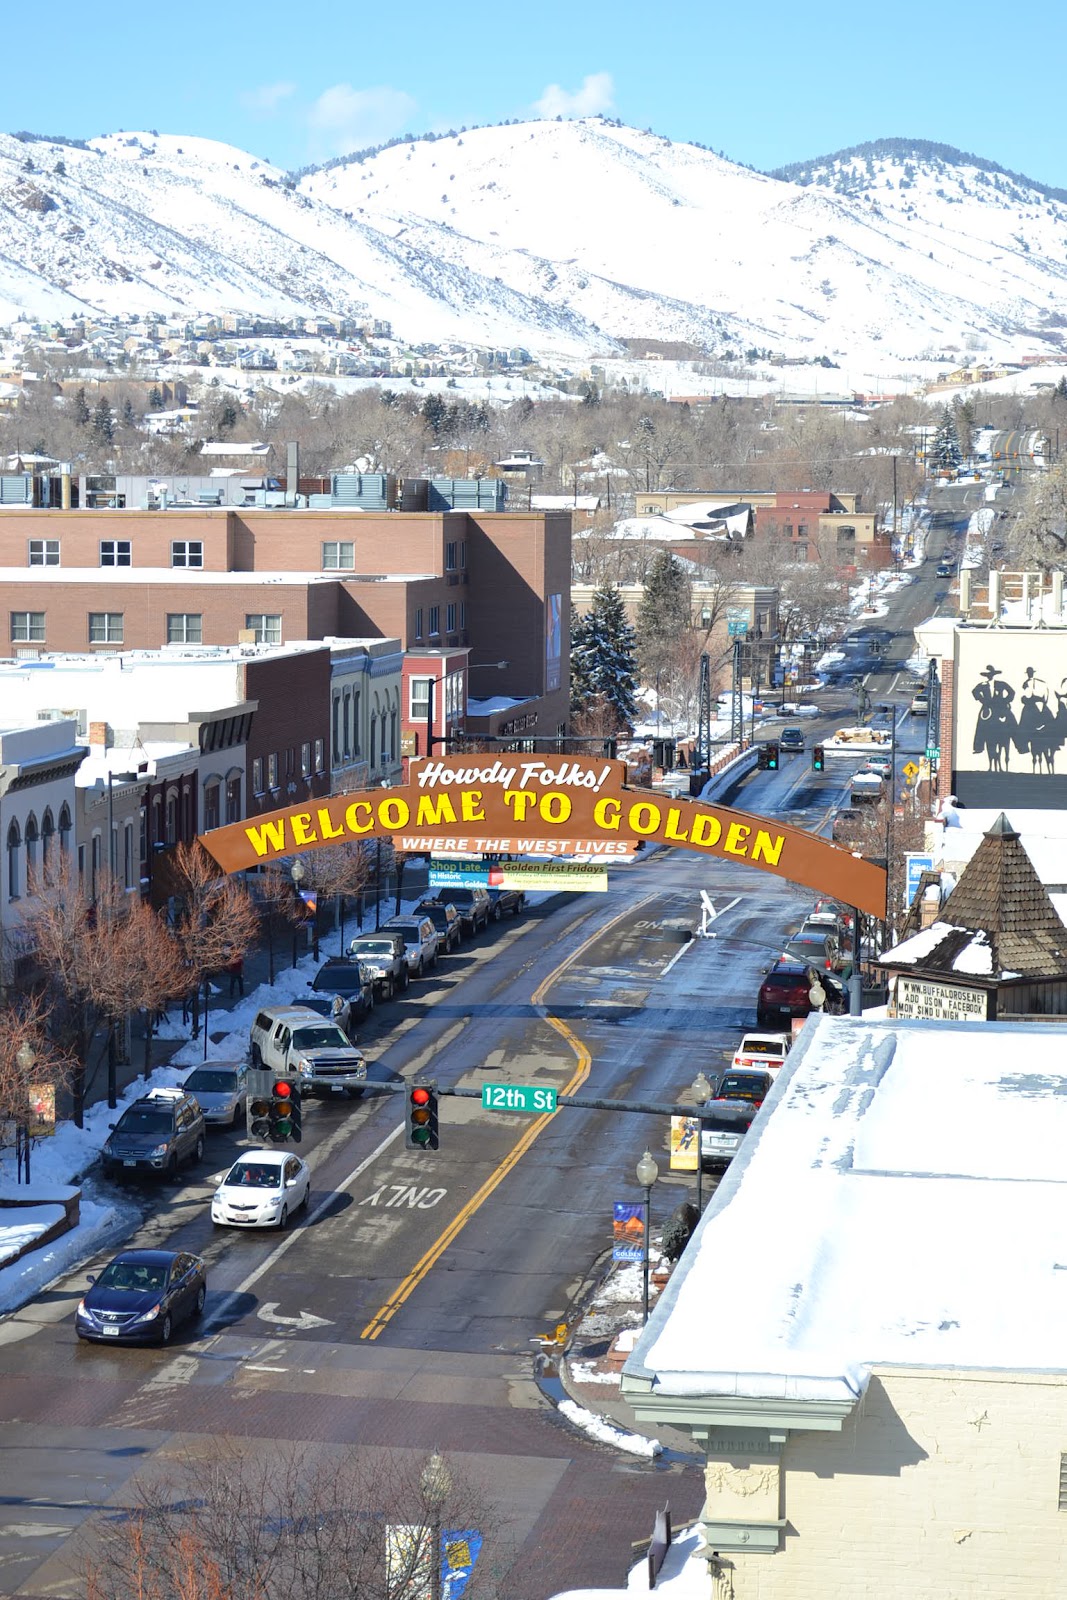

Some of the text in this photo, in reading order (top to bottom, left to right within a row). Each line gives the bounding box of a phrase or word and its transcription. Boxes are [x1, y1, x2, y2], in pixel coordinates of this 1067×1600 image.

[417, 761, 612, 793] Howdy Folks!
[245, 790, 785, 866] WELCOME TO GOLDEN
[402, 837, 628, 854] WHERE THE WEST LIVES
[430, 861, 456, 872] Shop
[503, 863, 604, 874] Golden First Fridays
[430, 880, 463, 888] Downtown
[438, 872, 461, 880] Historic
[898, 1003, 913, 1012] MON
[905, 994, 919, 1003] ADD
[949, 1000, 982, 1014] FACEBOOK
[485, 1087, 554, 1110] 12th St
[358, 1184, 448, 1209] ONLY
